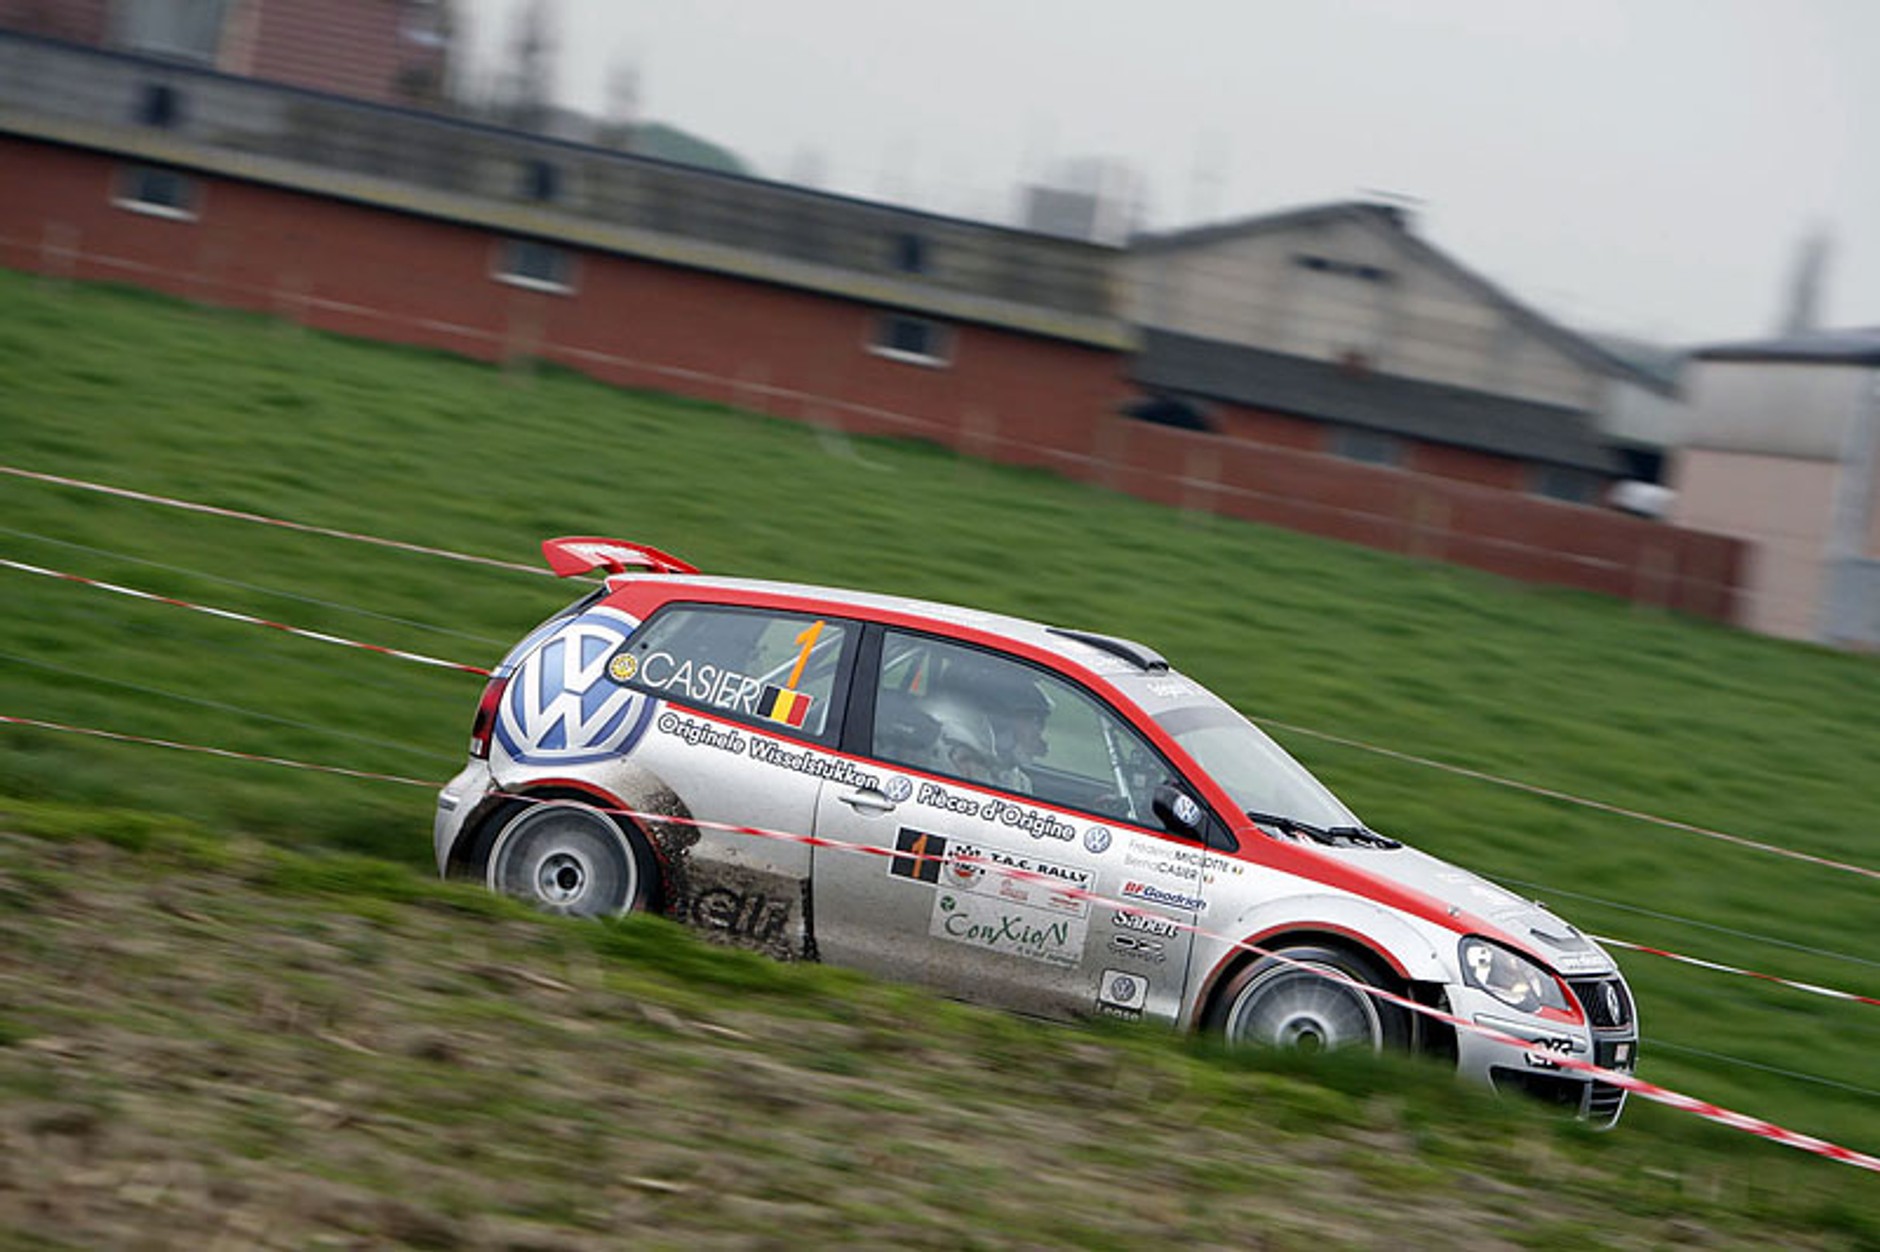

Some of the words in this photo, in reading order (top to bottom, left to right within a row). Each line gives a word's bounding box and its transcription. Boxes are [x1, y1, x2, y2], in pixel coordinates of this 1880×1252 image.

[641, 652, 760, 715] CASIER
[786, 620, 826, 690] 1
[658, 712, 746, 754] Originele
[750, 736, 879, 789] Wisselstukken
[918, 783, 978, 816] Pièces
[981, 799, 1075, 841] d'Origine
[911, 832, 928, 879] 1
[991, 853, 1031, 870] T.A.C.
[1037, 864, 1088, 882] RALLY
[1123, 881, 1208, 910] BFGoodrich
